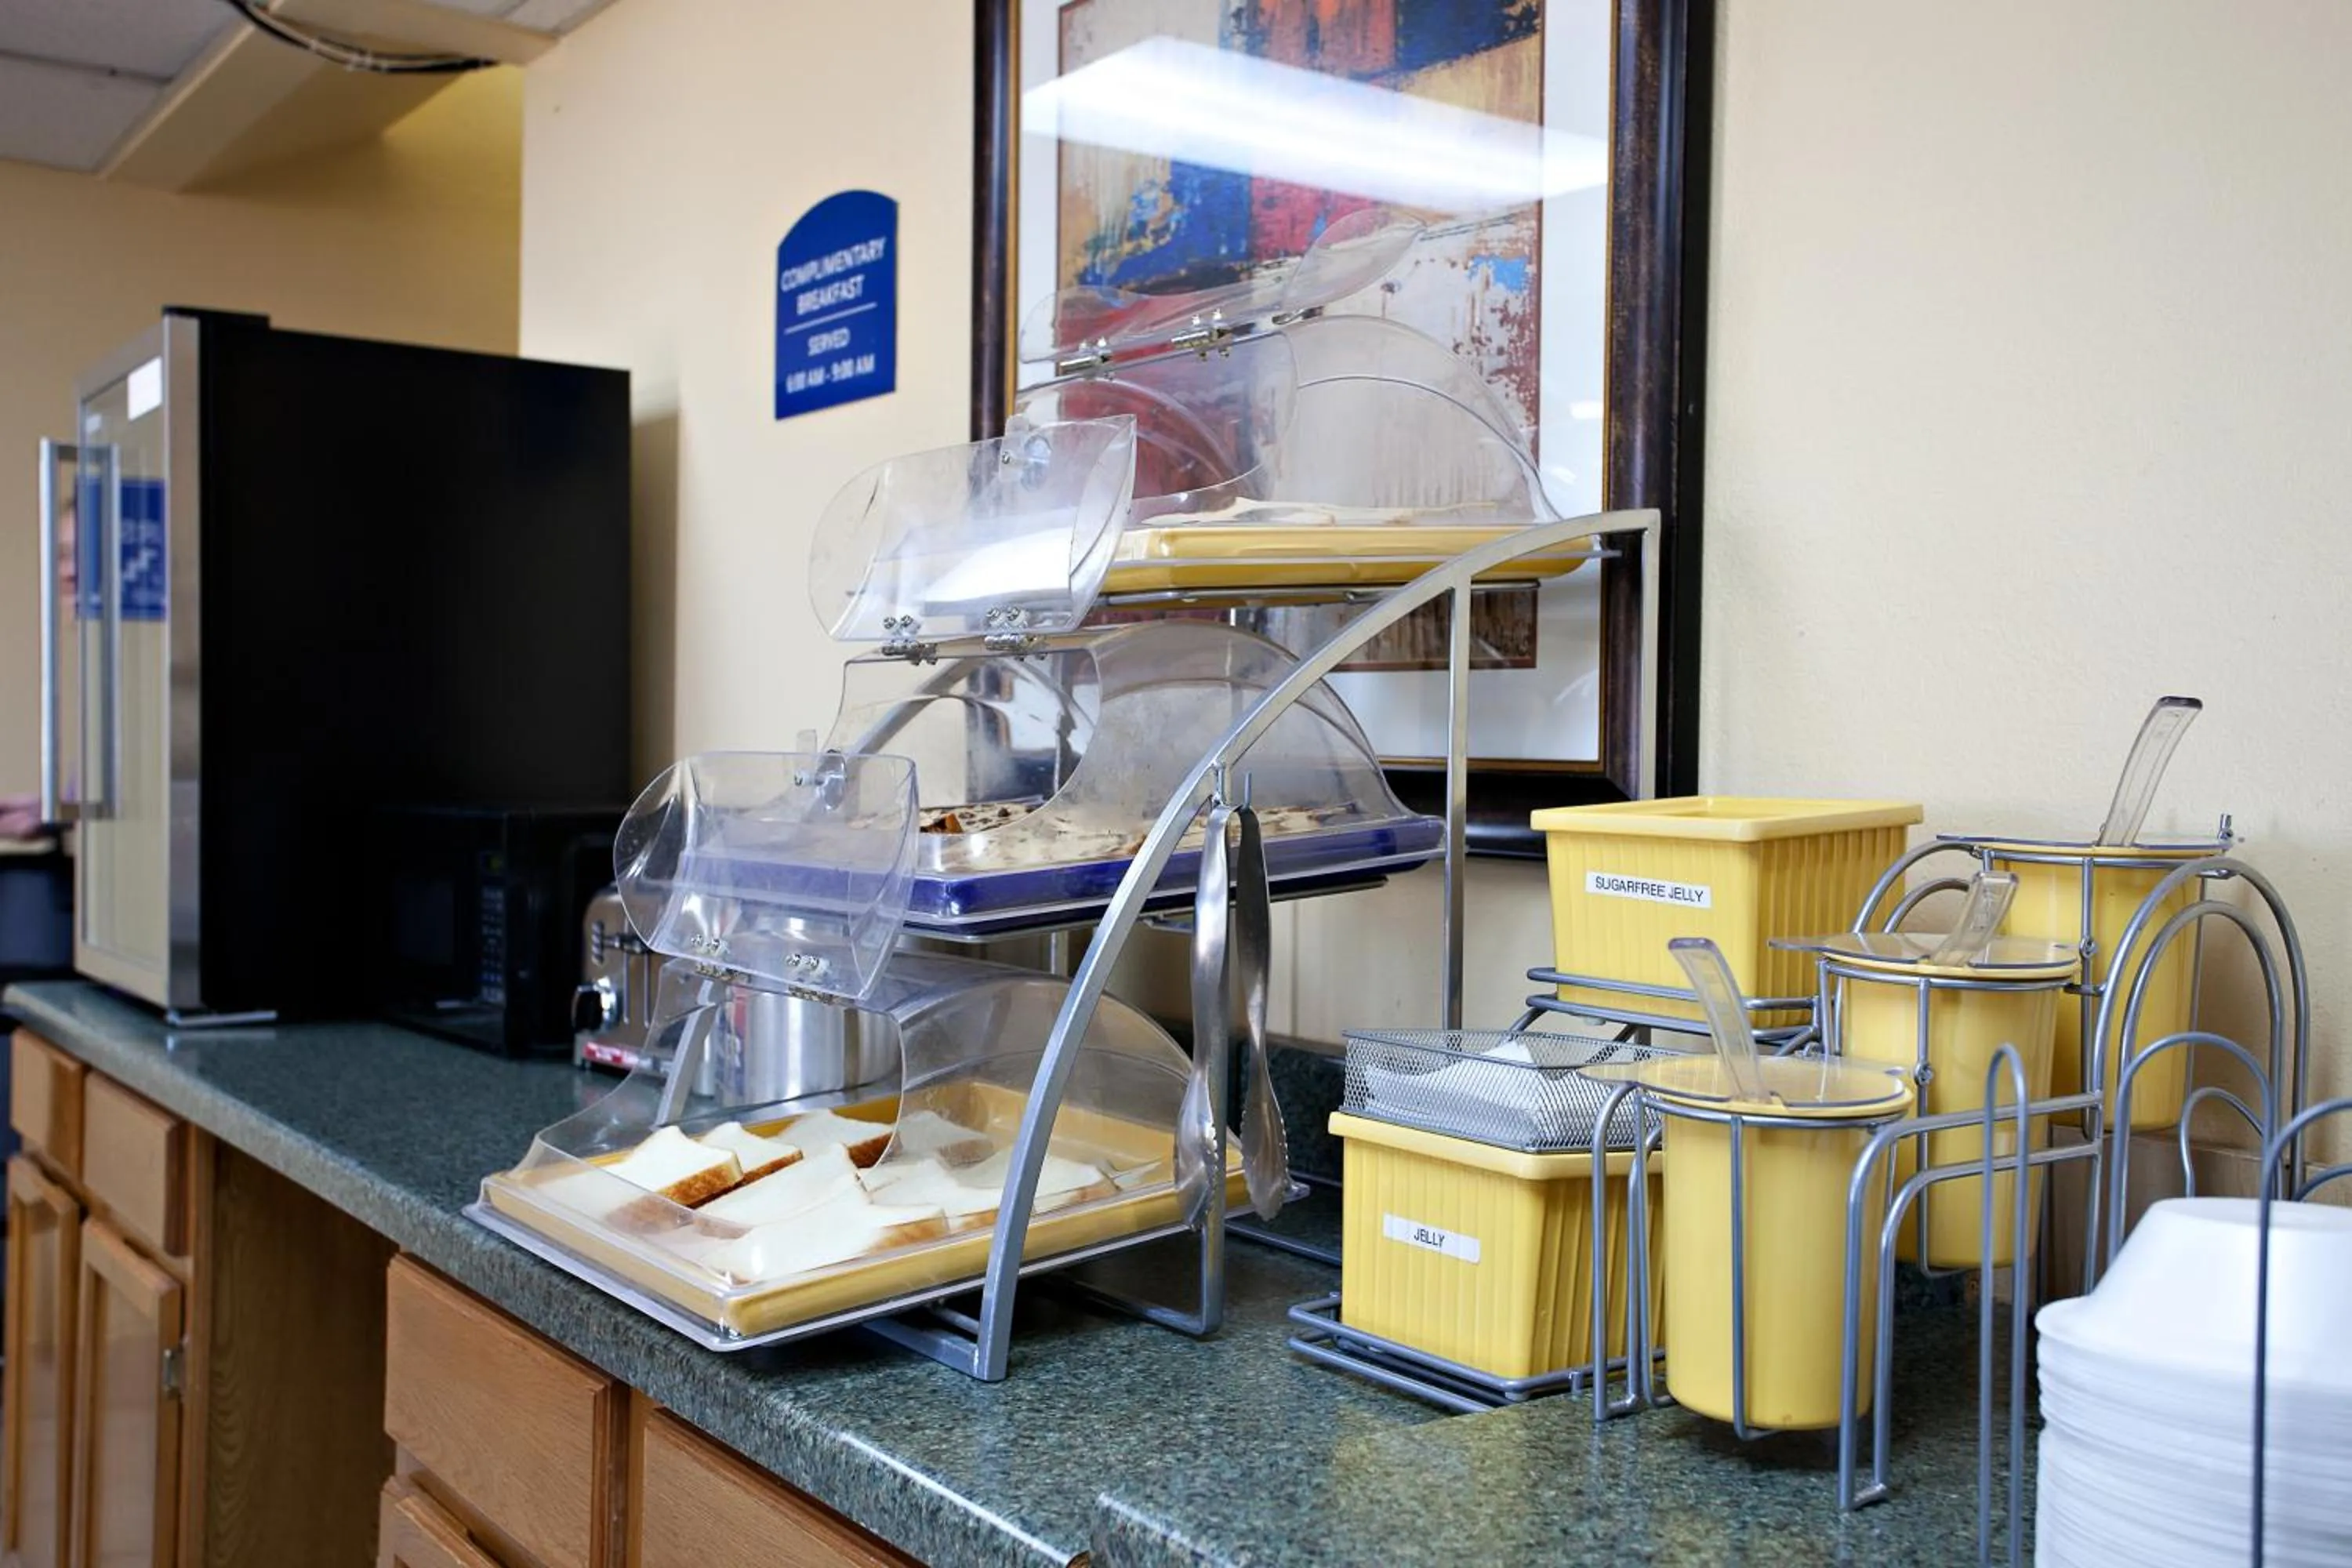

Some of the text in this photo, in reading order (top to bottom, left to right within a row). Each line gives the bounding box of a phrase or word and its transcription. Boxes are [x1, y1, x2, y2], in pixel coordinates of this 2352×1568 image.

[796, 274, 865, 315] BREAKFAST
[808, 327, 851, 357] SERVED
[1595, 876, 1704, 902] SUGARFREE JELLY
[1414, 1229, 1445, 1247] JELLY
